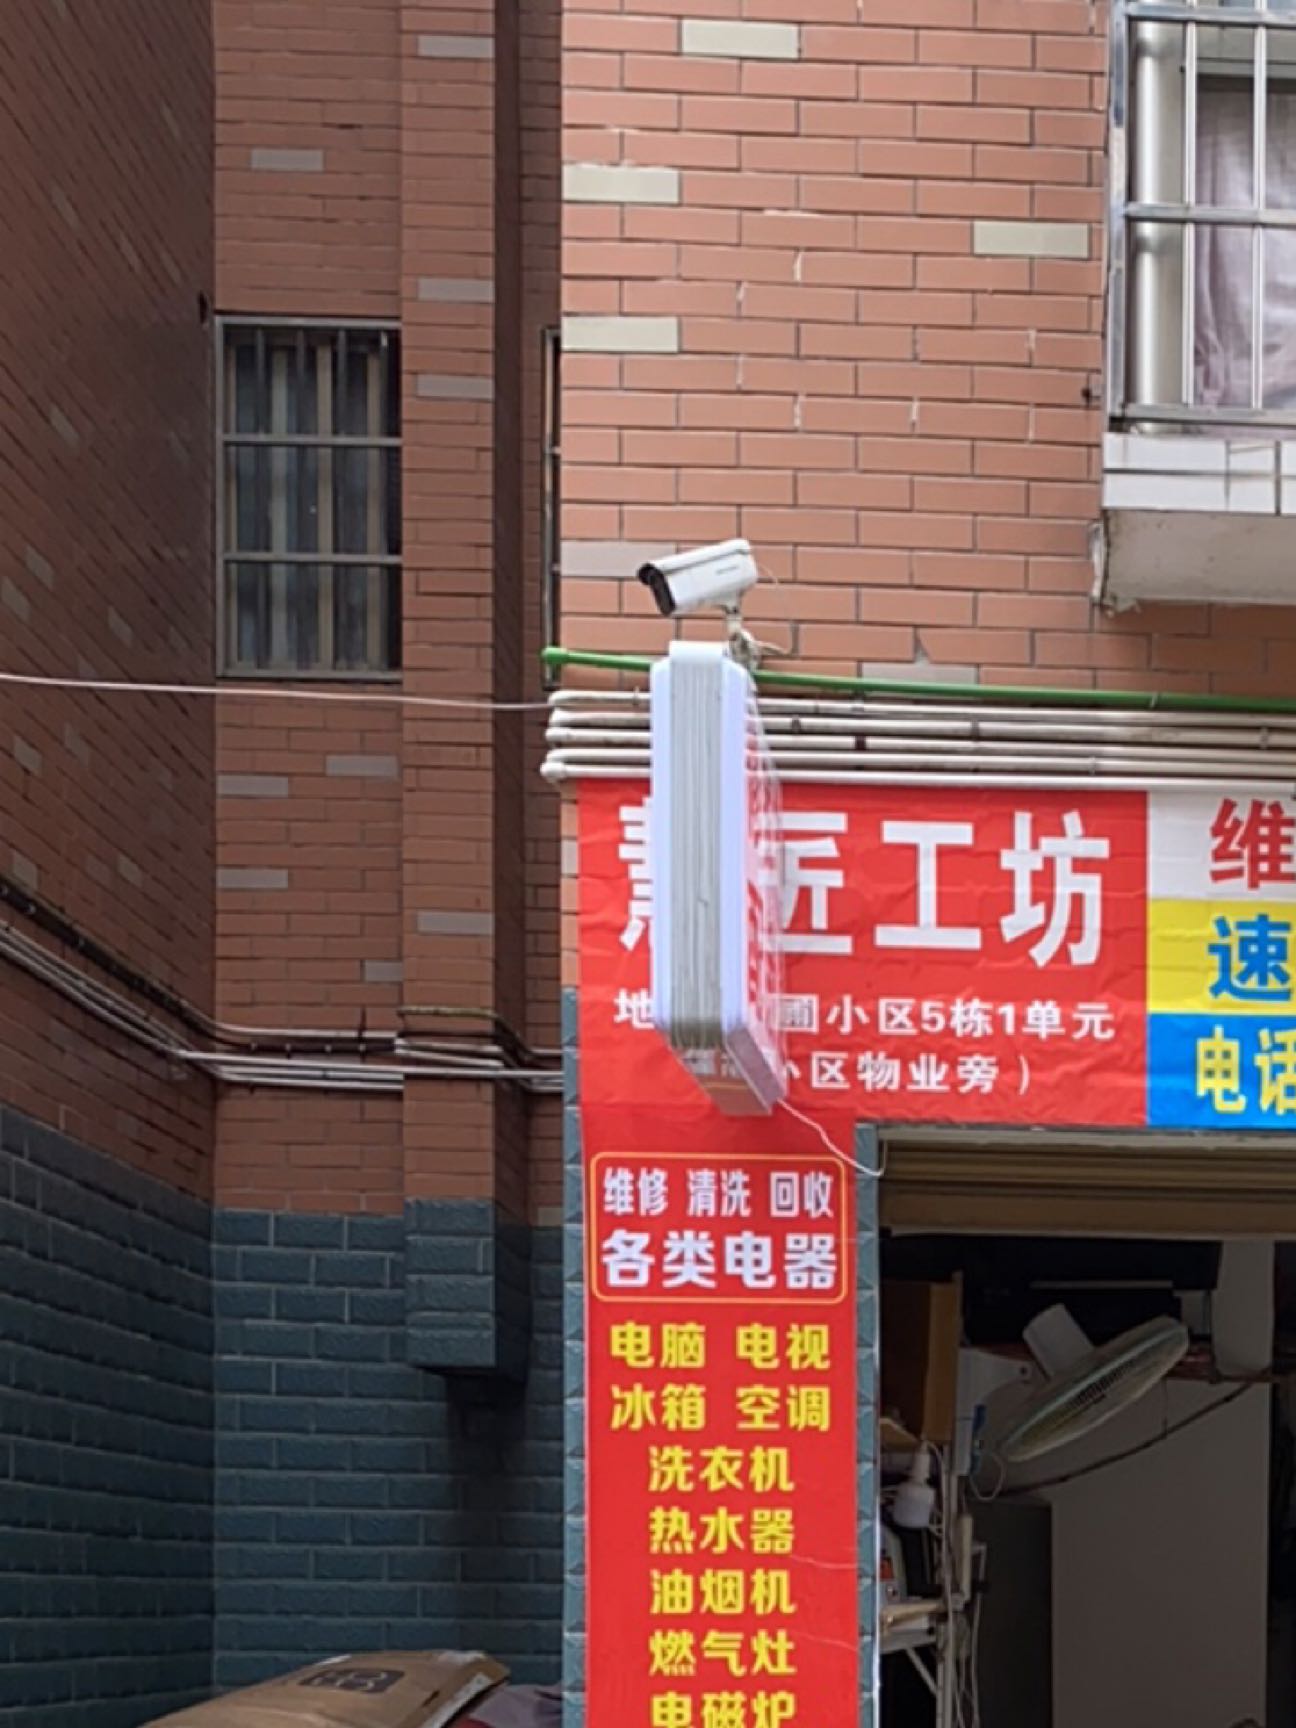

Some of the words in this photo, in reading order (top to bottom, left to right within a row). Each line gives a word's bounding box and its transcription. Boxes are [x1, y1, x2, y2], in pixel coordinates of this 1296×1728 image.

[603, 1166, 668, 1217] 维修
[686, 1168, 751, 1218] 清洗
[770, 1171, 834, 1219] 回收
[602, 1228, 838, 1290] 各类电器
[610, 1320, 706, 1370] 电脑
[736, 1322, 831, 1371] 电视
[610, 1382, 706, 1432] 冰箱
[736, 1384, 831, 1433] 空调
[648, 1446, 796, 1493] 洗衣机
[648, 1506, 796, 1555] 热水器
[649, 1568, 797, 1616] 油烟机
[649, 1629, 798, 1678] 燃气灶
